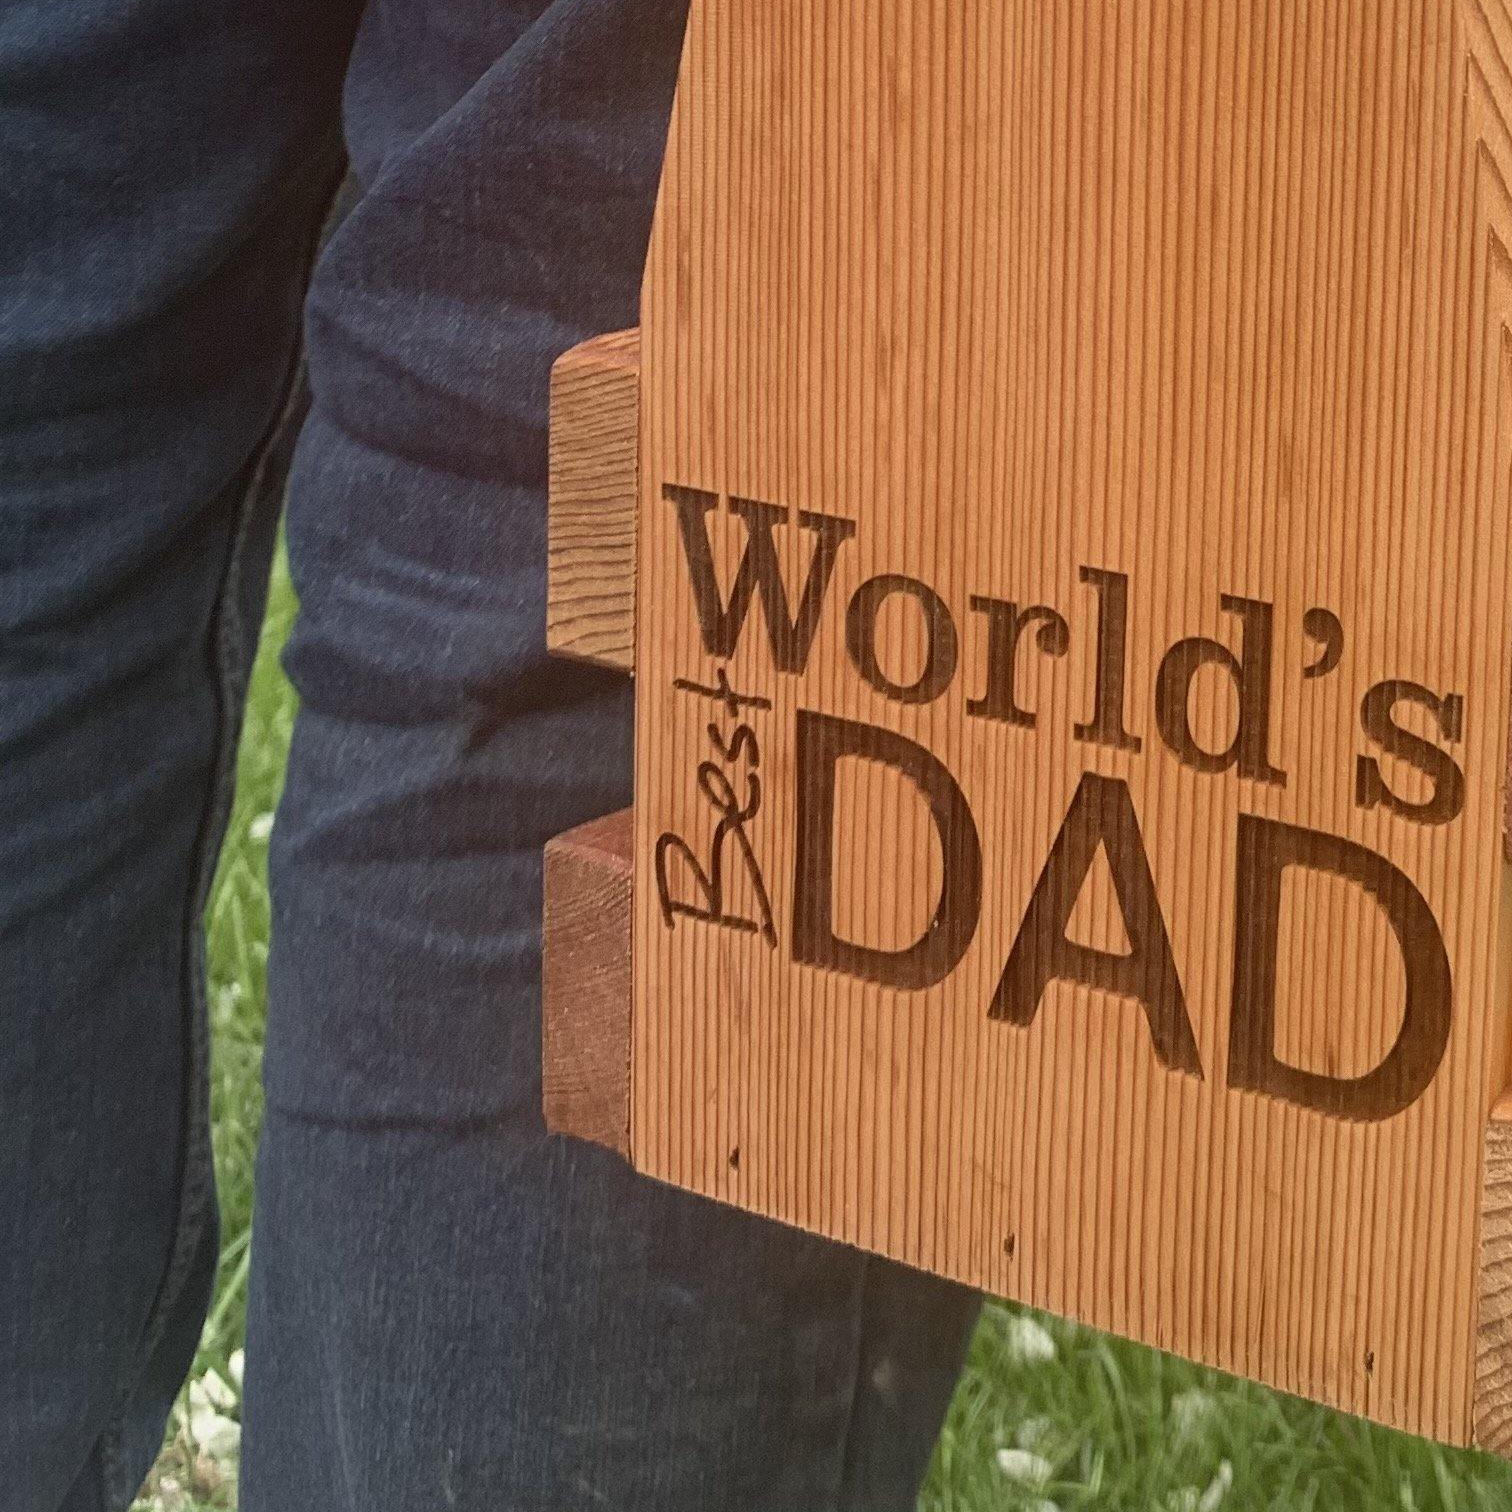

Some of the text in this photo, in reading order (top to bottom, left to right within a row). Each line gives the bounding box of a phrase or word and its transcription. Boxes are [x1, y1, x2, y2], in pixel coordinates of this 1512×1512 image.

[655, 666, 778, 950] Best
[661, 482, 1467, 827] World's
[790, 707, 1453, 1124] DAD
